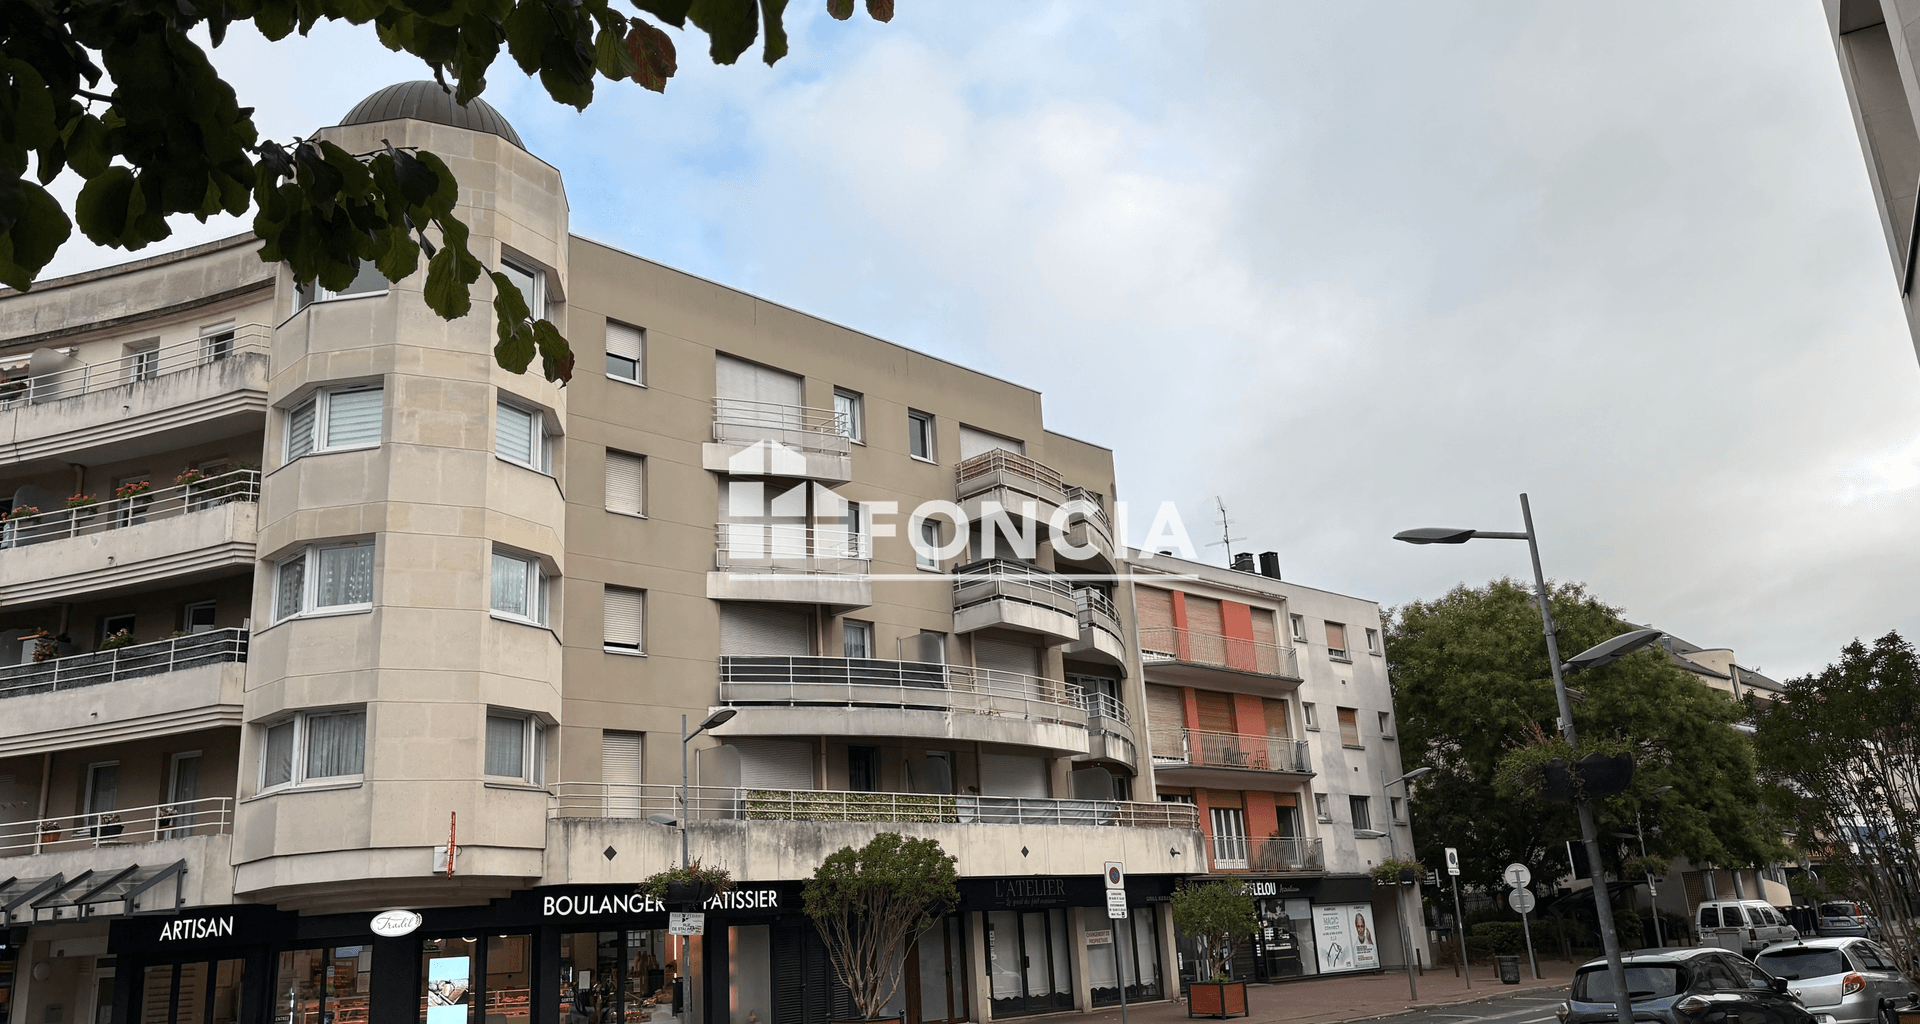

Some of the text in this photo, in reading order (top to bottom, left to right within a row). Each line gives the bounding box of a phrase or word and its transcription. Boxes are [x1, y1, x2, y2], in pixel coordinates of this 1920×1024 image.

[995, 879, 1065, 898] L'ATELIER
[543, 893, 667, 916] BOULANGER
[159, 916, 233, 941] ARTISAN
